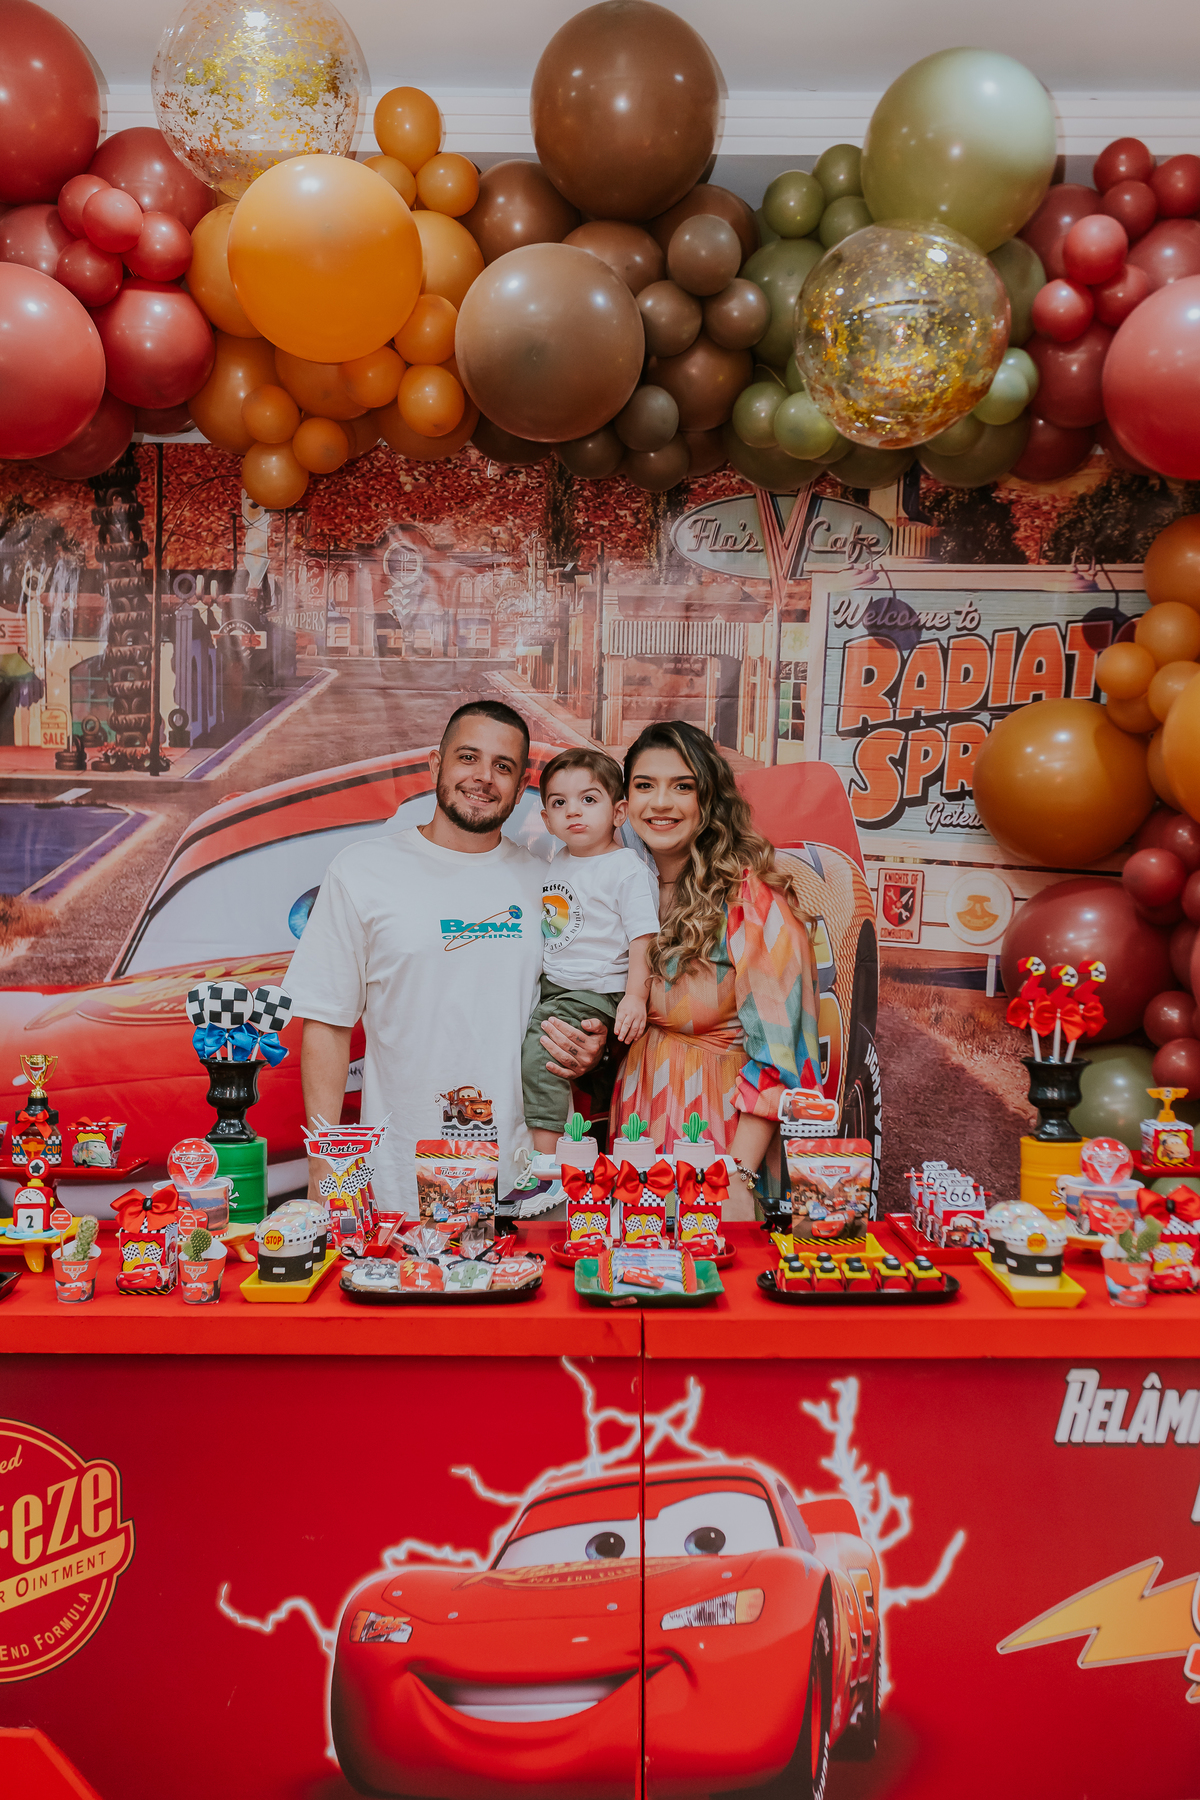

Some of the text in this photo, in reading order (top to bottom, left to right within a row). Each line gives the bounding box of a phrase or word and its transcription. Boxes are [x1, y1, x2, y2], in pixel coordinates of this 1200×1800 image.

[806, 516, 883, 563] Cafe
[285, 611, 325, 631] WIPERS
[833, 597, 981, 632] Welcome to
[838, 618, 1116, 734] RADIAT
[43, 732, 65, 746] SALE
[850, 718, 1002, 824] SPR
[884, 872, 919, 885] KNIGHTS OF
[542, 883, 573, 902] Reserva
[318, 1141, 364, 1154] Bento
[950, 1187, 971, 1202] 66
[25, 1215, 34, 1228] 2
[265, 1235, 282, 1245] STOP
[494, 1262, 530, 1275] TOP
[1054, 1368, 1200, 1445] RELÂM
[0, 1466, 113, 1565] eze
[15, 1551, 107, 1598] OINTMENT
[0, 1592, 92, 1662] END FORMULA
